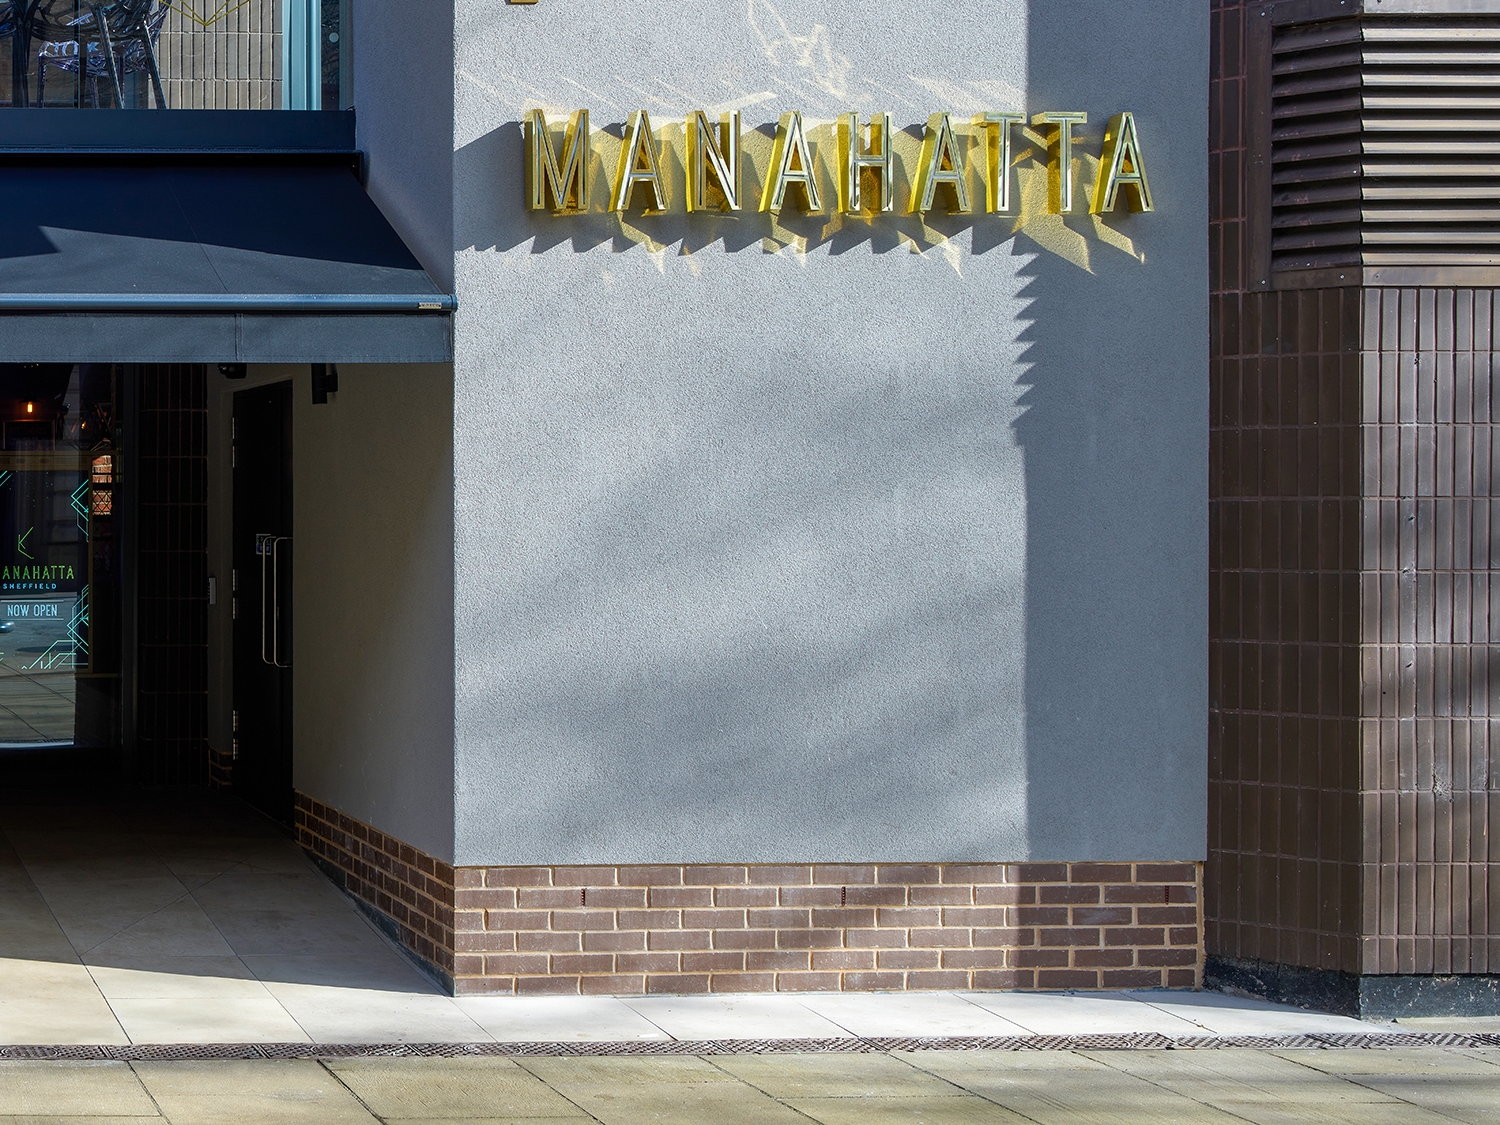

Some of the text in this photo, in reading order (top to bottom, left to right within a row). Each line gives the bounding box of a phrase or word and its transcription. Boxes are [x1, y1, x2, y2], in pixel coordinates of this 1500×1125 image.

[523, 109, 1153, 214] MANAHATTA
[7, 605, 58, 617] NOW OPEN
